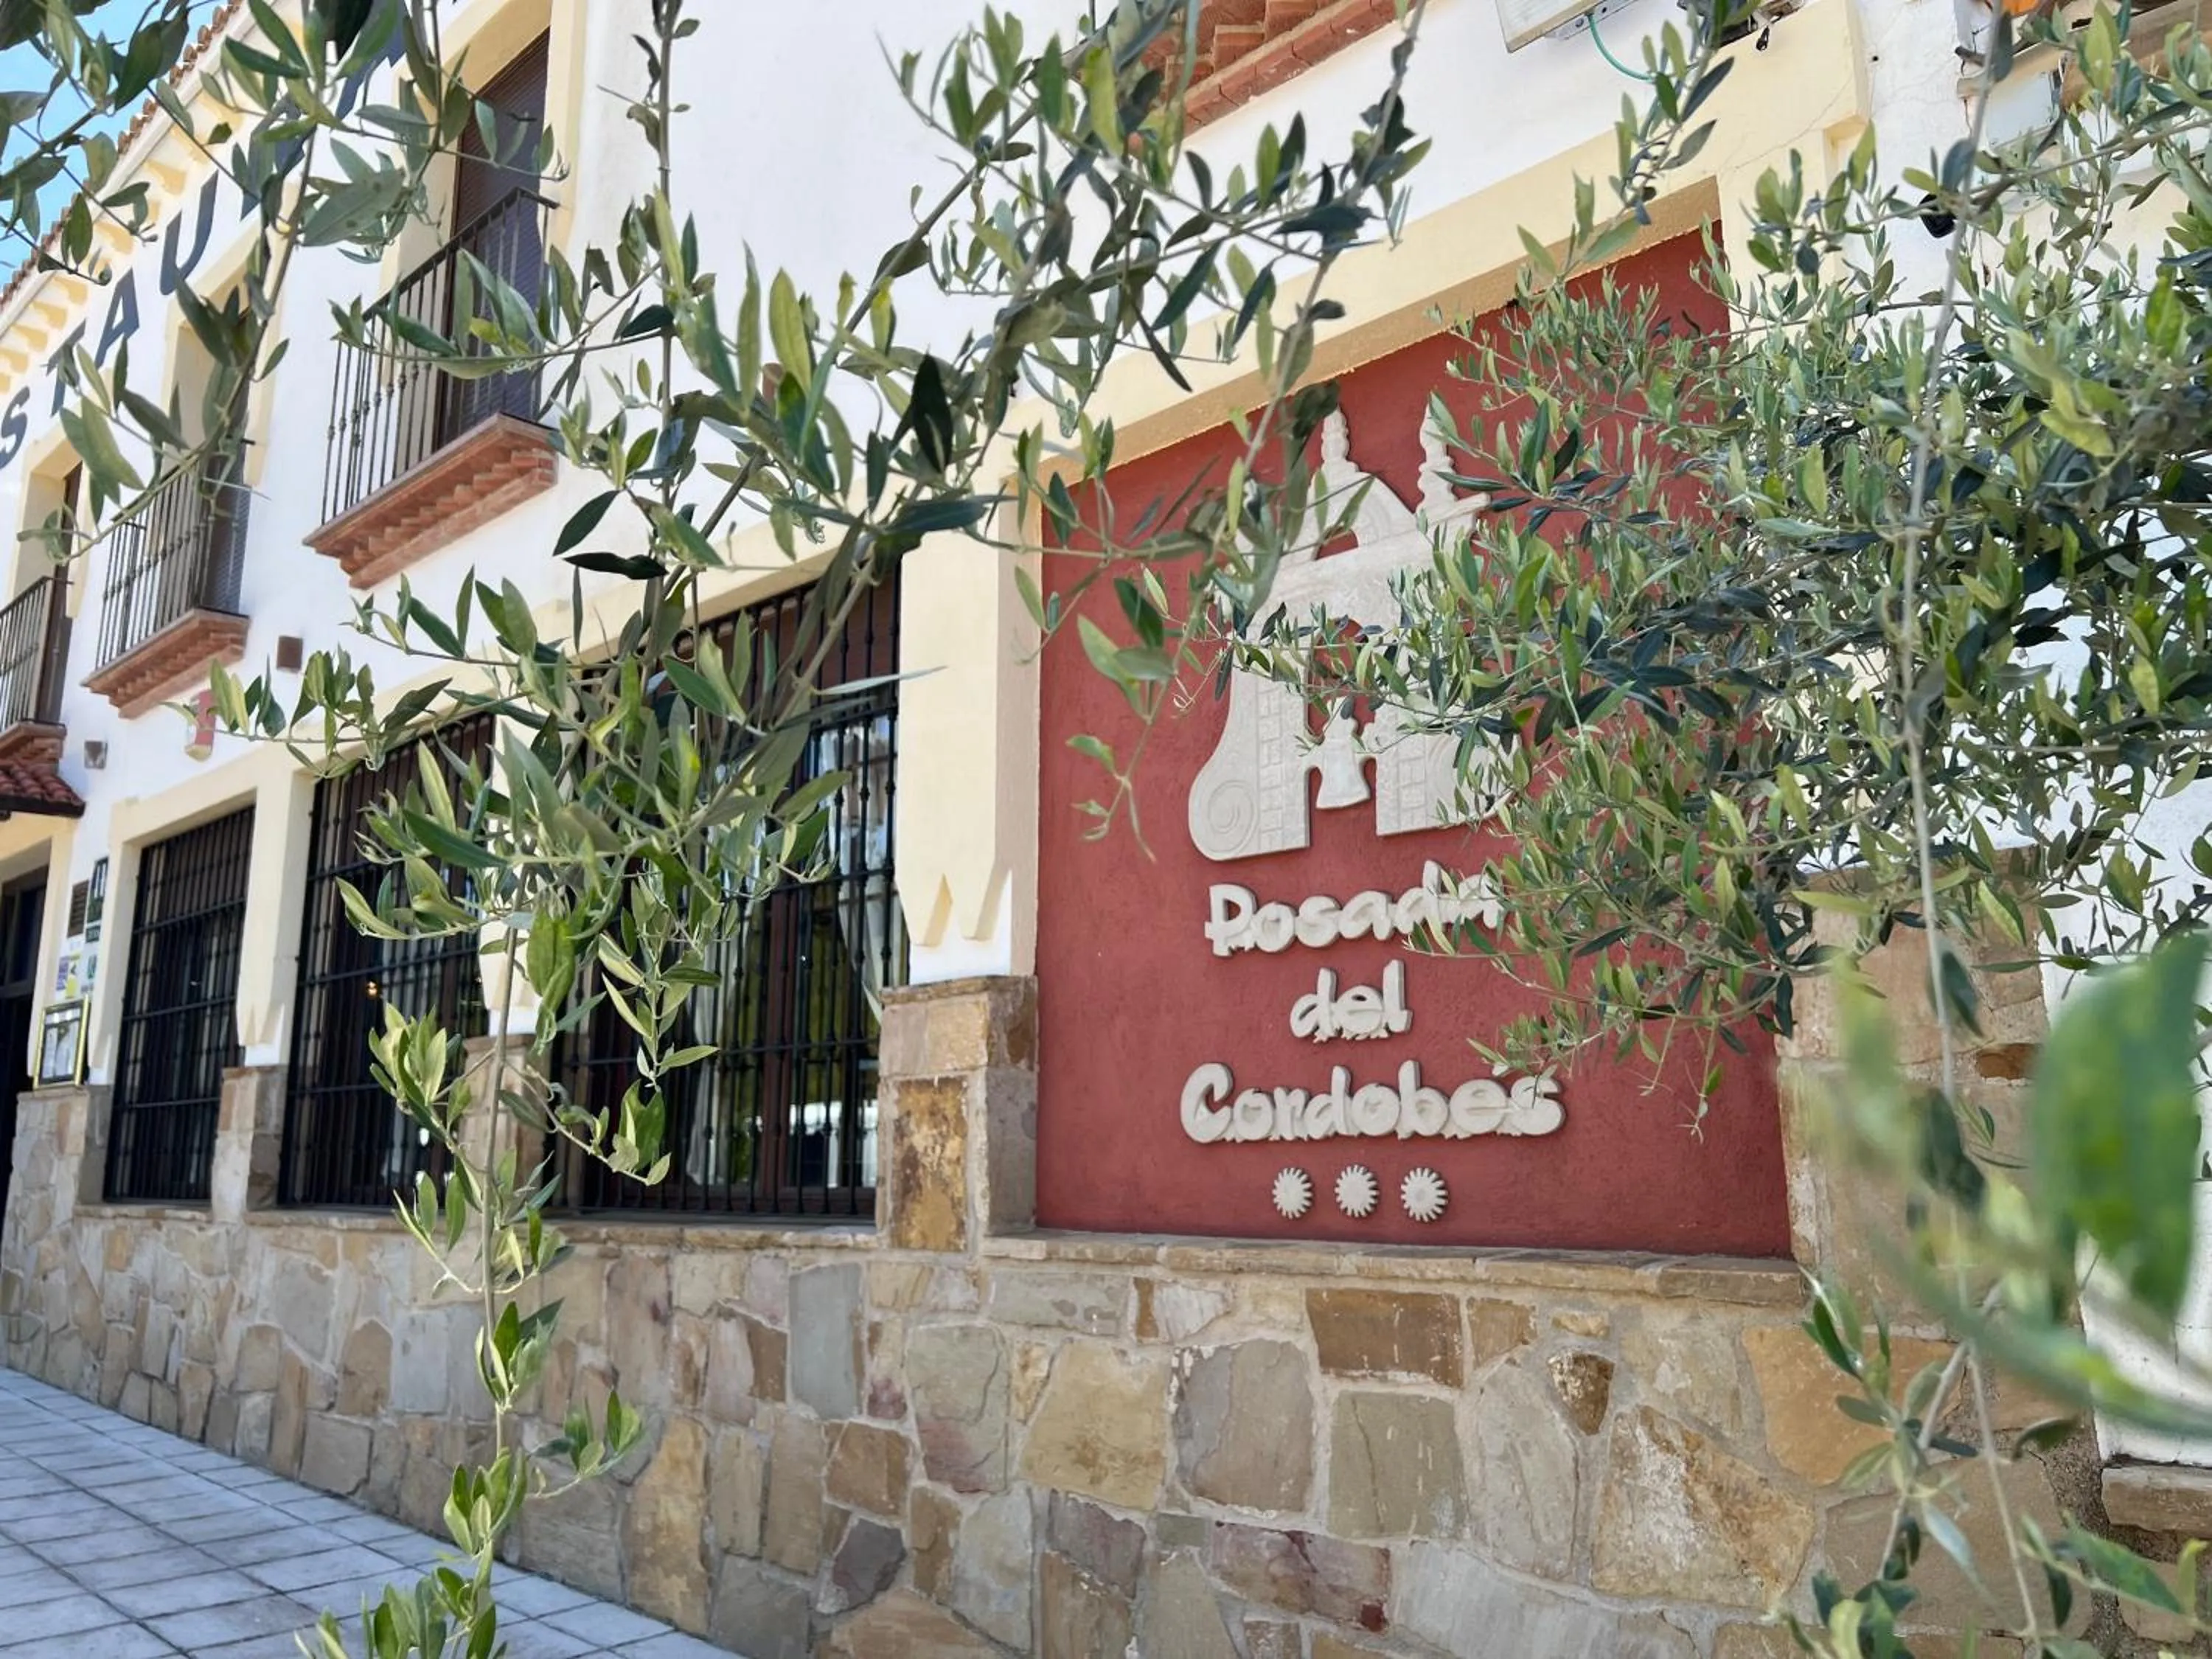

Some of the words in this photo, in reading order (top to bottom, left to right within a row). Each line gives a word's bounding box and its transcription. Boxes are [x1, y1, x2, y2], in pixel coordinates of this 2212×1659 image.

[1204, 859, 1504, 957] Posada
[1290, 959, 1412, 1043] del
[1180, 1060, 1565, 1144] Cordobes
